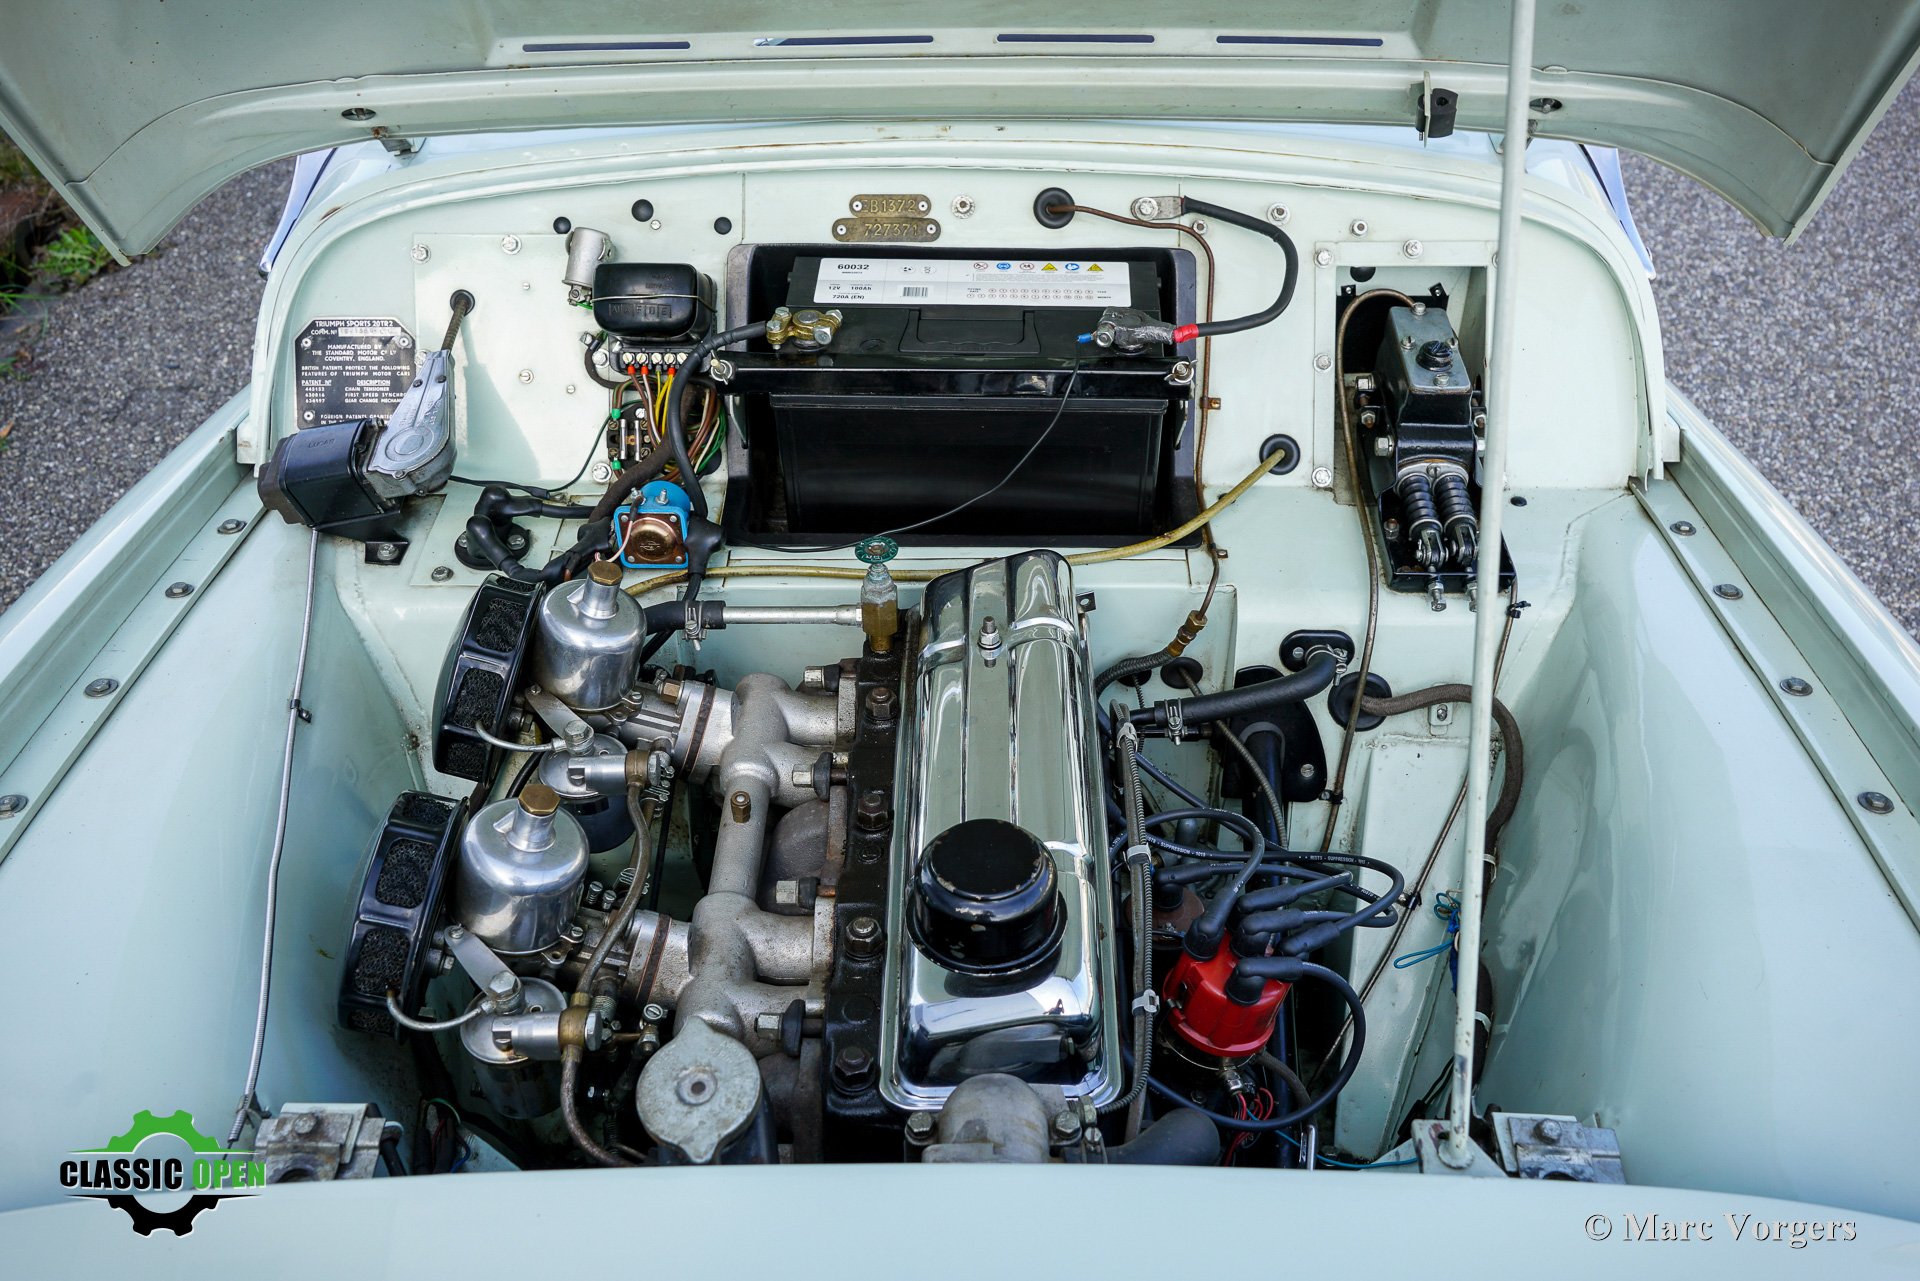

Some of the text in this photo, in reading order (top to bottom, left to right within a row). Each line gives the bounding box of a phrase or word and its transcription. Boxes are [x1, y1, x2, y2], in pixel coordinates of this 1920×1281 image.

[863, 223, 918, 236] 727371
[837, 263, 870, 271] 60032
[1160, 842, 1191, 855] SUPPRESSION
